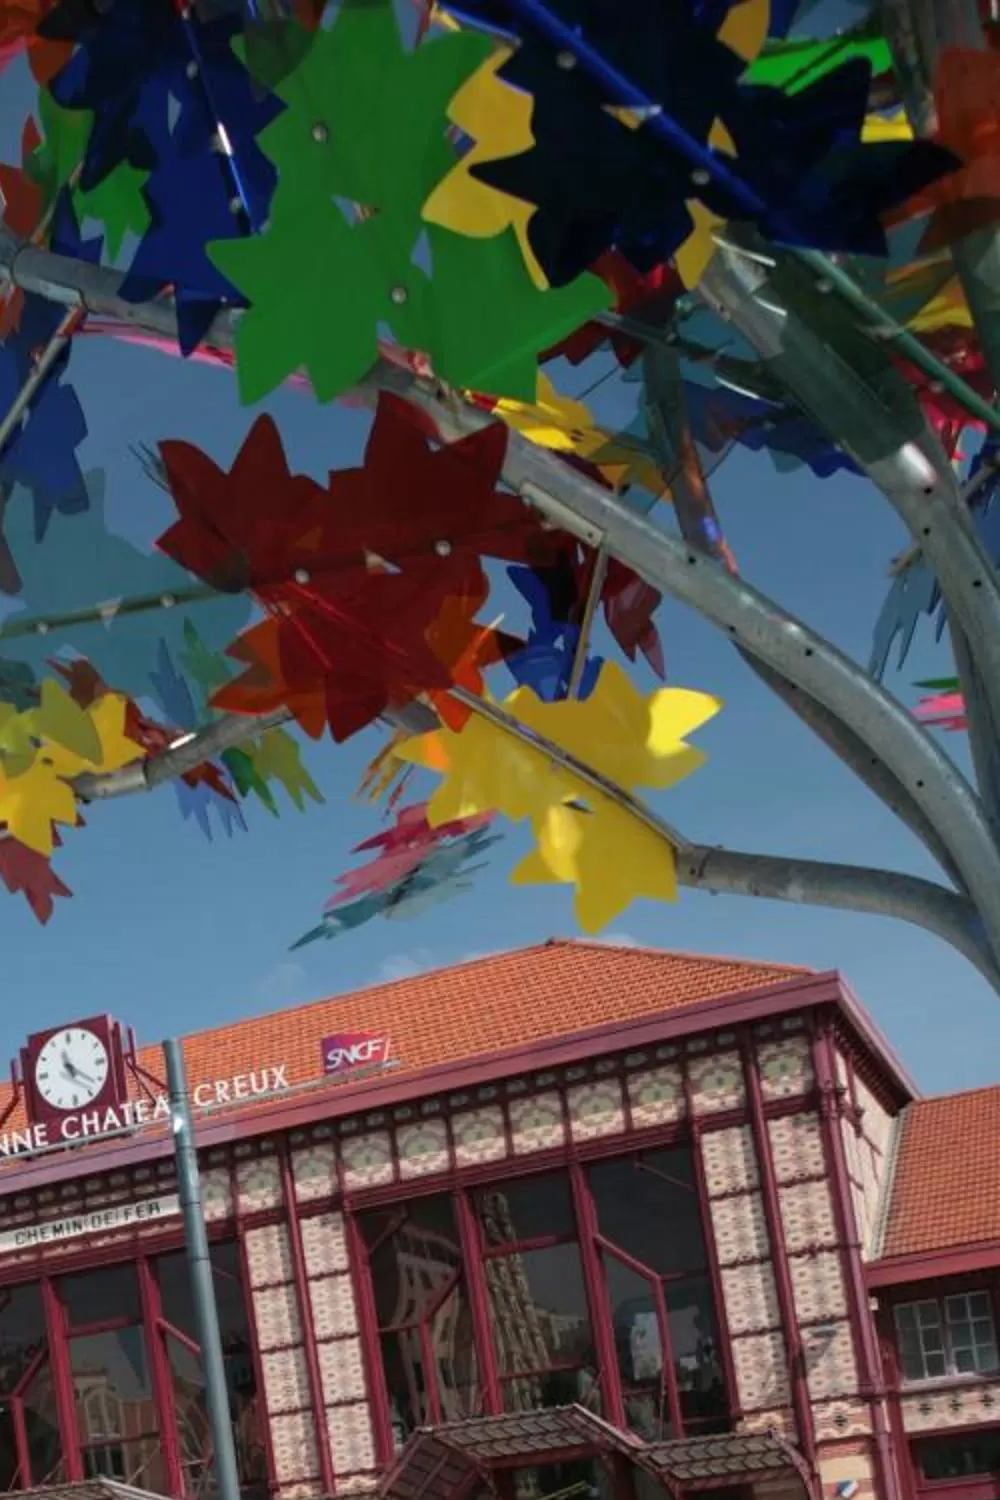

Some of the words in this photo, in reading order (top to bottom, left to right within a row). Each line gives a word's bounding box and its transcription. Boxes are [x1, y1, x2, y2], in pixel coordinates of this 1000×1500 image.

[326, 1038, 385, 1069] SNCF
[60, 1093, 173, 1140] CHATEA
[193, 1064, 290, 1108] CREUX
[15, 1219, 84, 1246] CHEMIN
[91, 1210, 114, 1229] DE
[123, 1200, 162, 1221] FER
